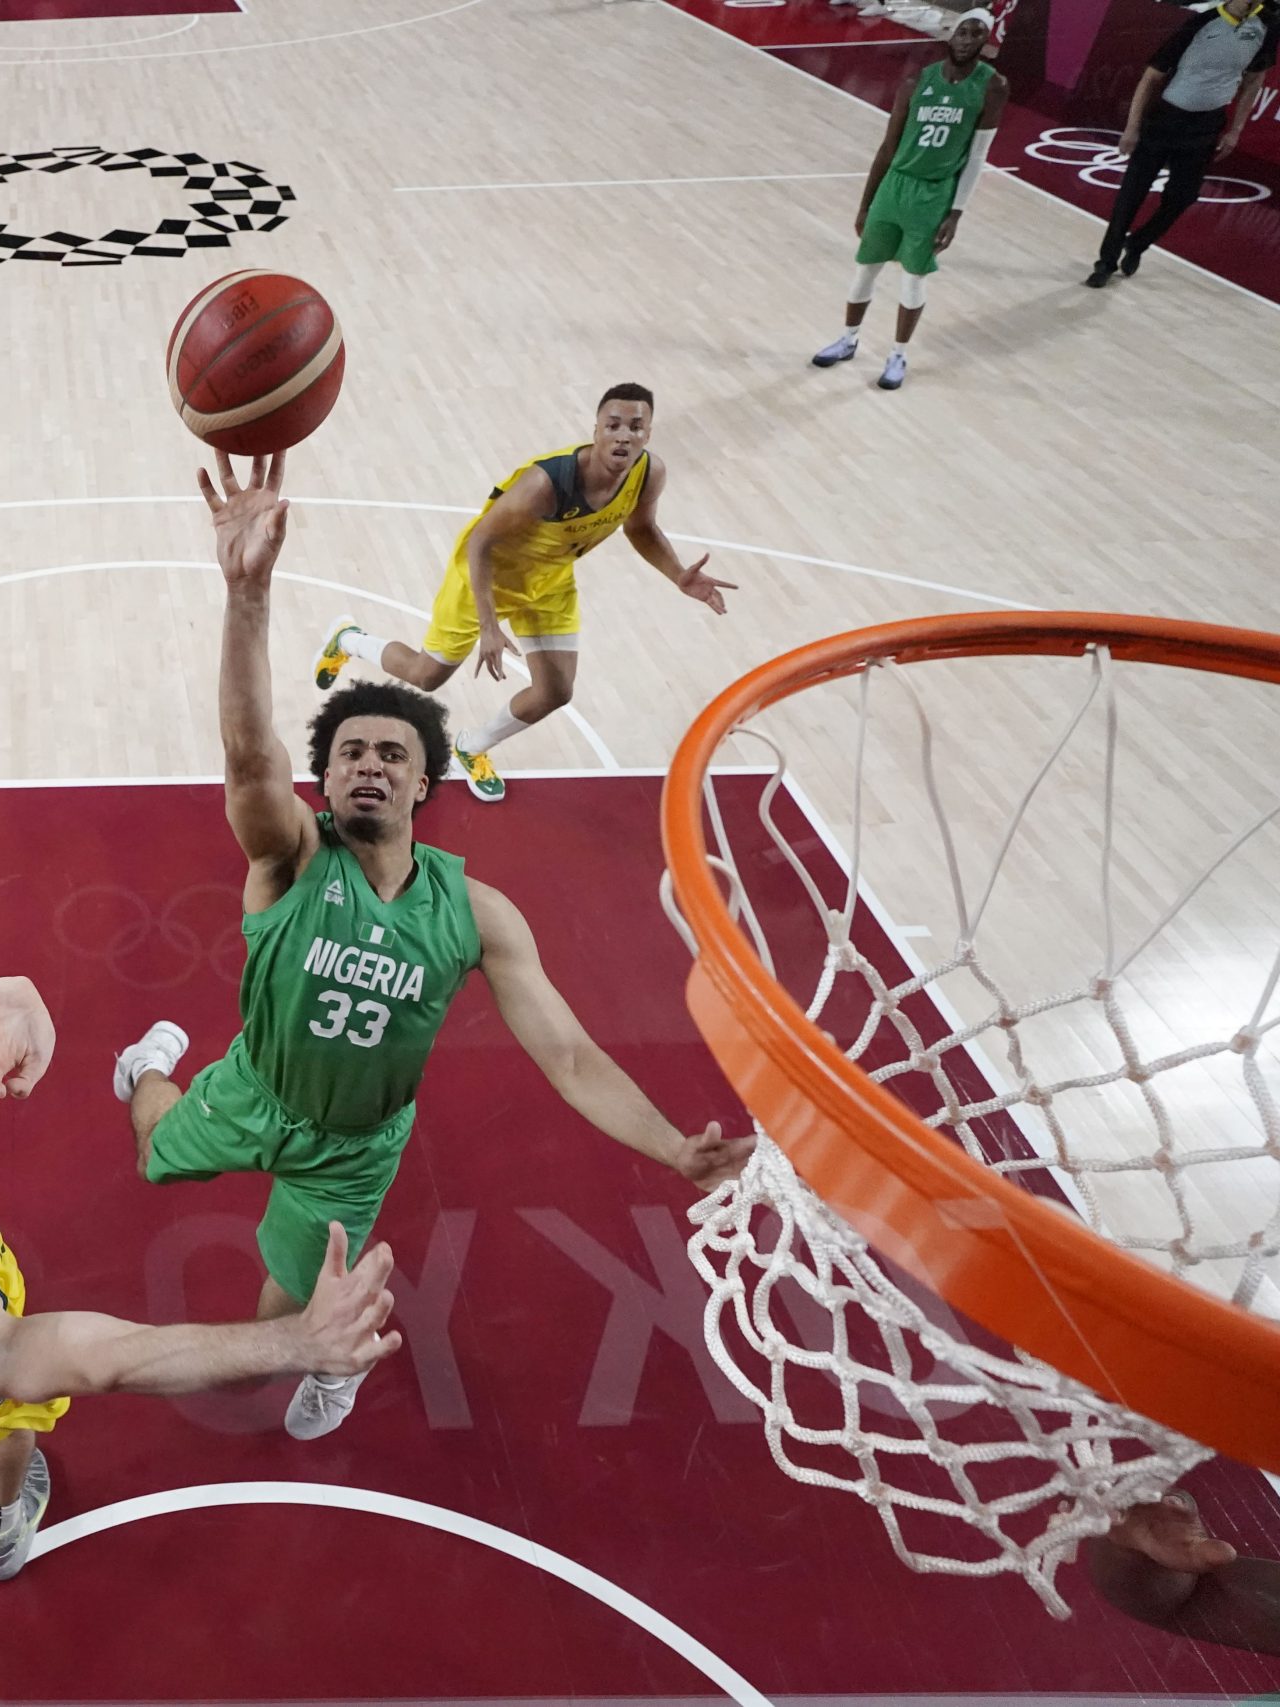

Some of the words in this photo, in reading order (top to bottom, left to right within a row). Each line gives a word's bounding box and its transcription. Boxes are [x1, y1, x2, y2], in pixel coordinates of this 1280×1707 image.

[917, 106, 964, 124] NIGERIA
[918, 124, 951, 148] 20
[304, 937, 424, 1002] NIGERIA
[309, 989, 391, 1048] 33
